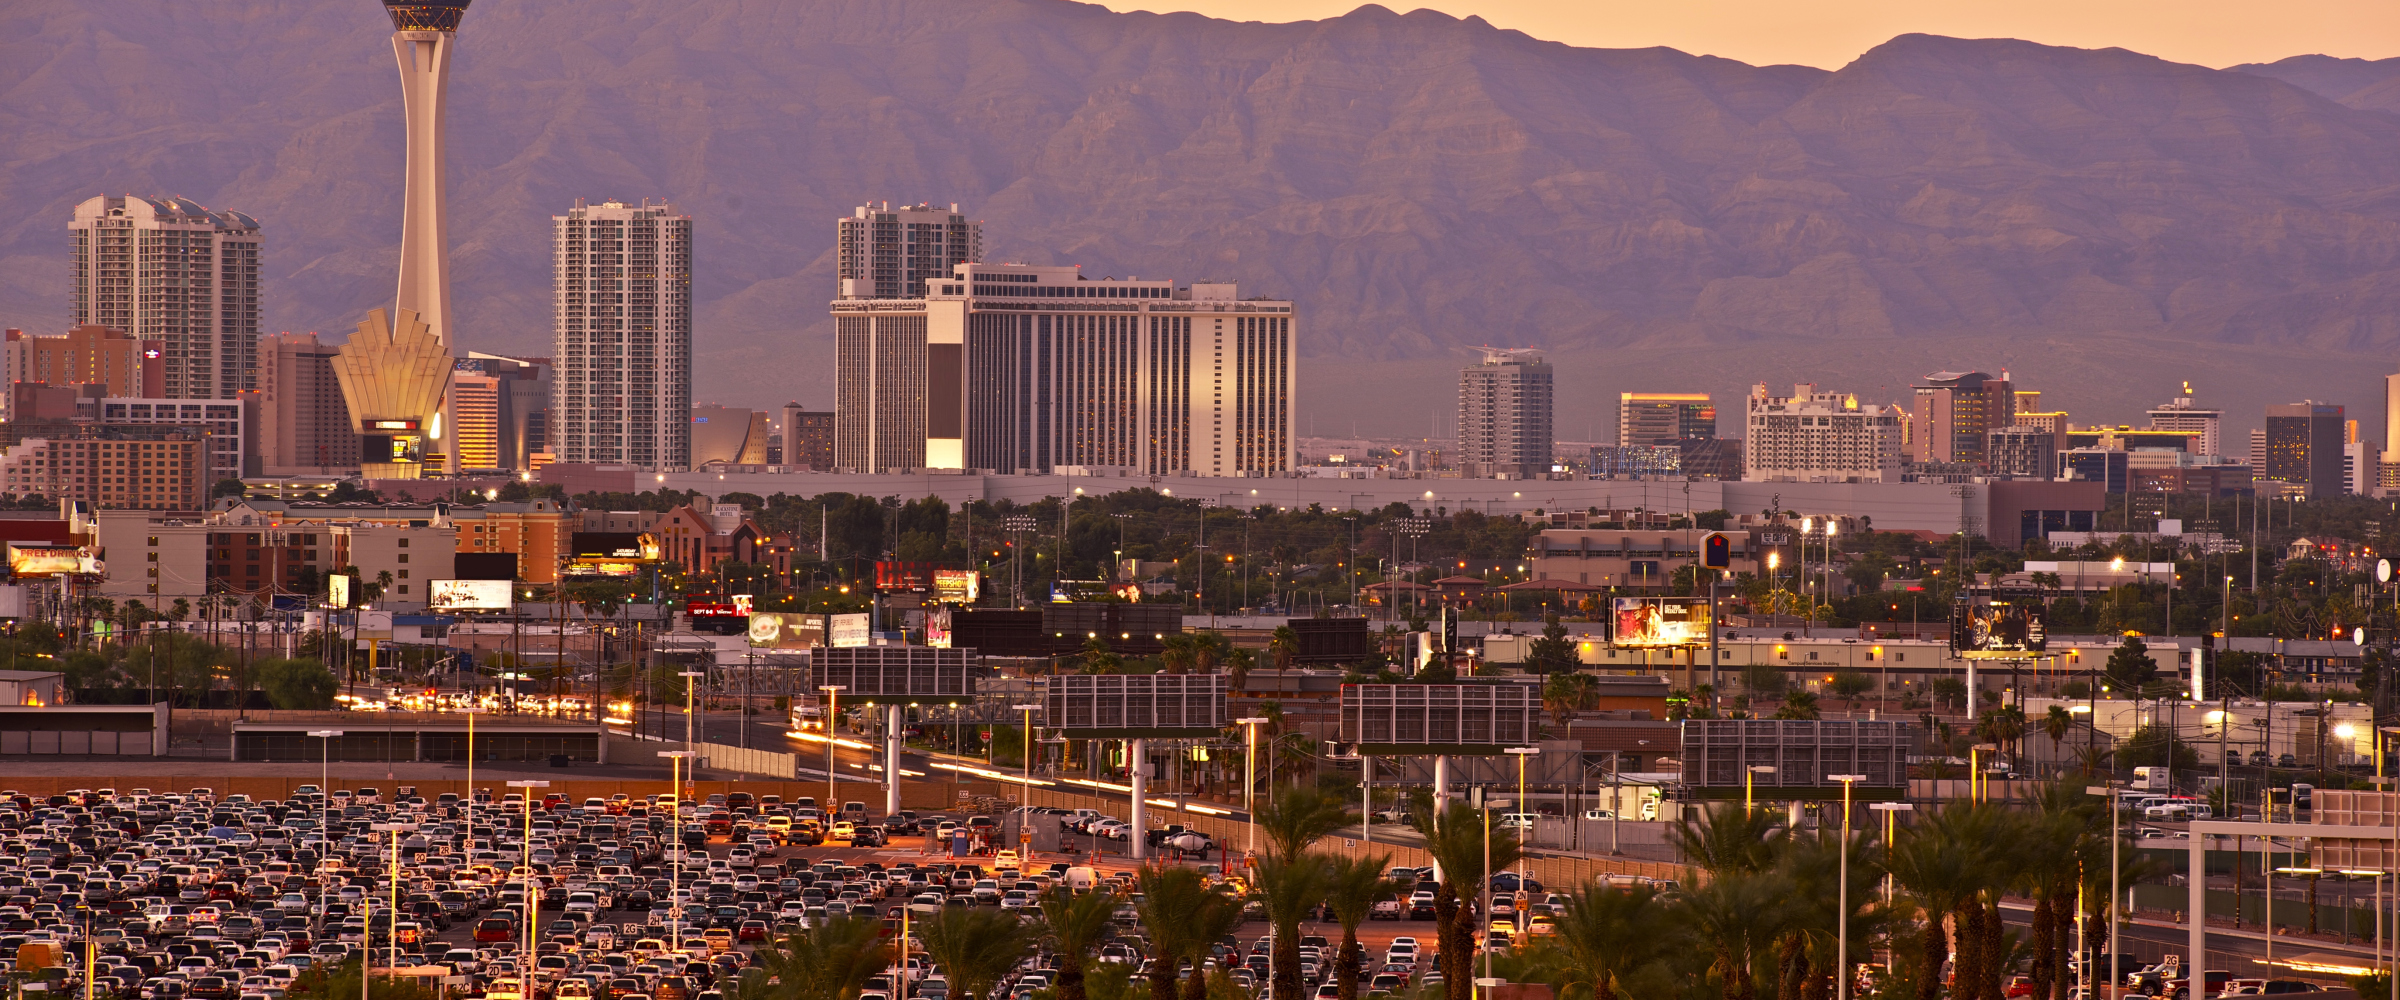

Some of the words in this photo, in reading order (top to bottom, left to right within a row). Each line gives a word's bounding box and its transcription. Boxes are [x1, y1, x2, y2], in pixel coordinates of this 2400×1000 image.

[20, 549, 47, 557] FREE
[49, 549, 90, 558] DRINKS
[416, 854, 425, 862] 2Q
[600, 898, 610, 906] 2K
[671, 909, 680, 917] 2J
[650, 917, 659, 925] 2H
[626, 924, 636, 933] 2G
[601, 939, 610, 948] 2F
[519, 956, 528, 965] 2E
[2166, 955, 2177, 965] 2G
[489, 966, 499, 975] 2D
[459, 982, 469, 992] 2C
[2227, 983, 2237, 992] 2F
